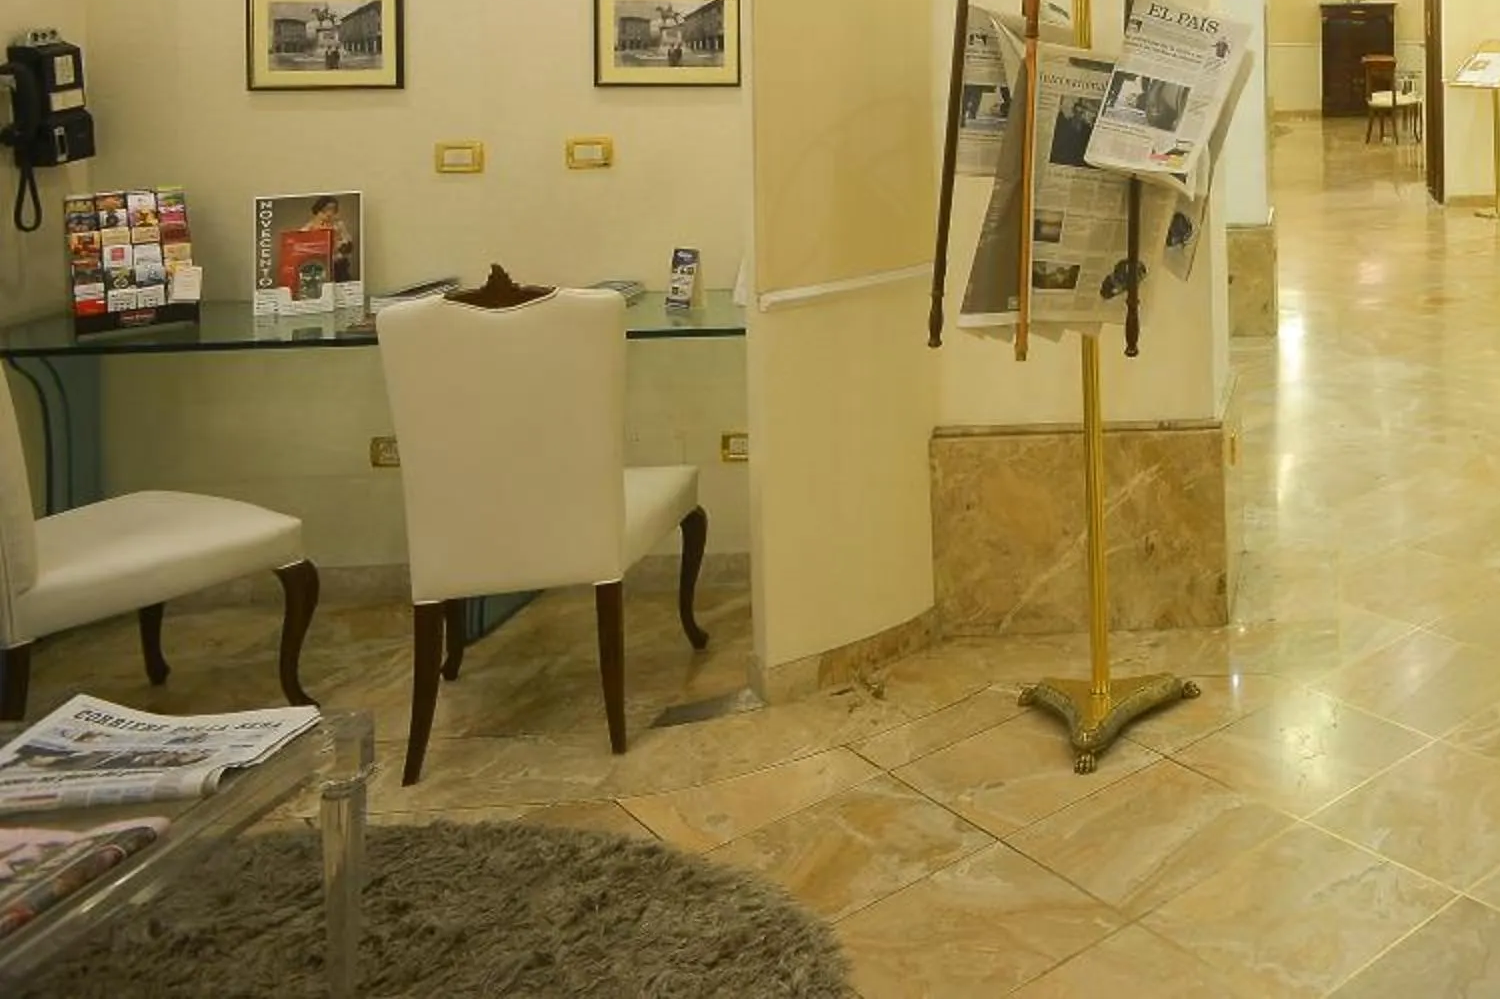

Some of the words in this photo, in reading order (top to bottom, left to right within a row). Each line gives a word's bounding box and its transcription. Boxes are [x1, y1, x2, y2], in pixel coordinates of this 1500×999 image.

[1147, 2, 1172, 22] EL
[259, 200, 273, 287] NOVECENTO
[73, 709, 169, 732] CORRIERE
